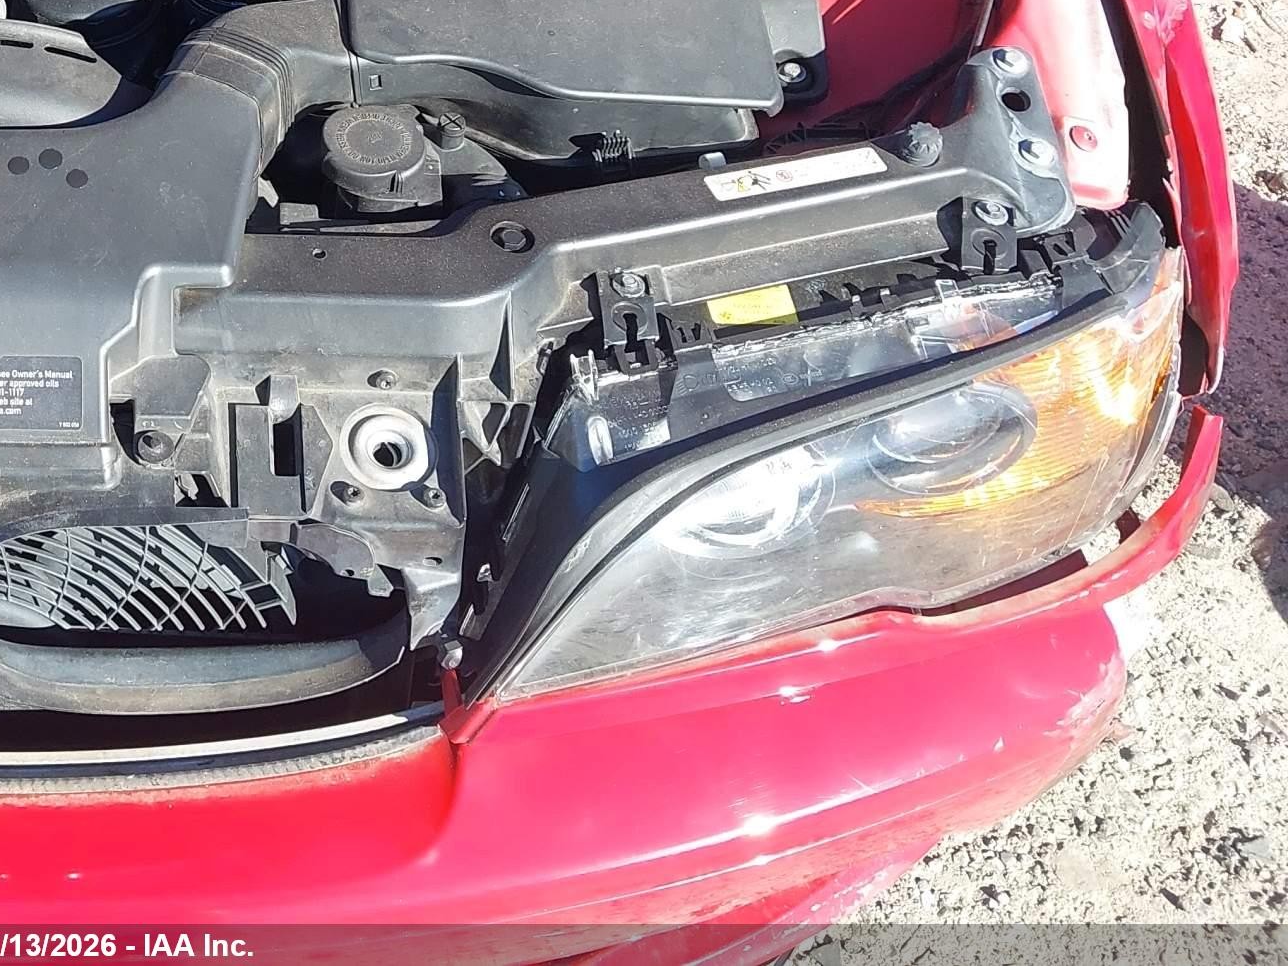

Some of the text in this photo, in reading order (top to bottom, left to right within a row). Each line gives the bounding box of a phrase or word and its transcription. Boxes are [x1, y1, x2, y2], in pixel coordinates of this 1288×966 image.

[12, 369, 43, 379] Owner's
[44, 370, 73, 379] Manual
[9, 379, 44, 388] approved
[45, 379, 60, 388] oils
[9, 397, 24, 406] site
[25, 398, 33, 406] at
